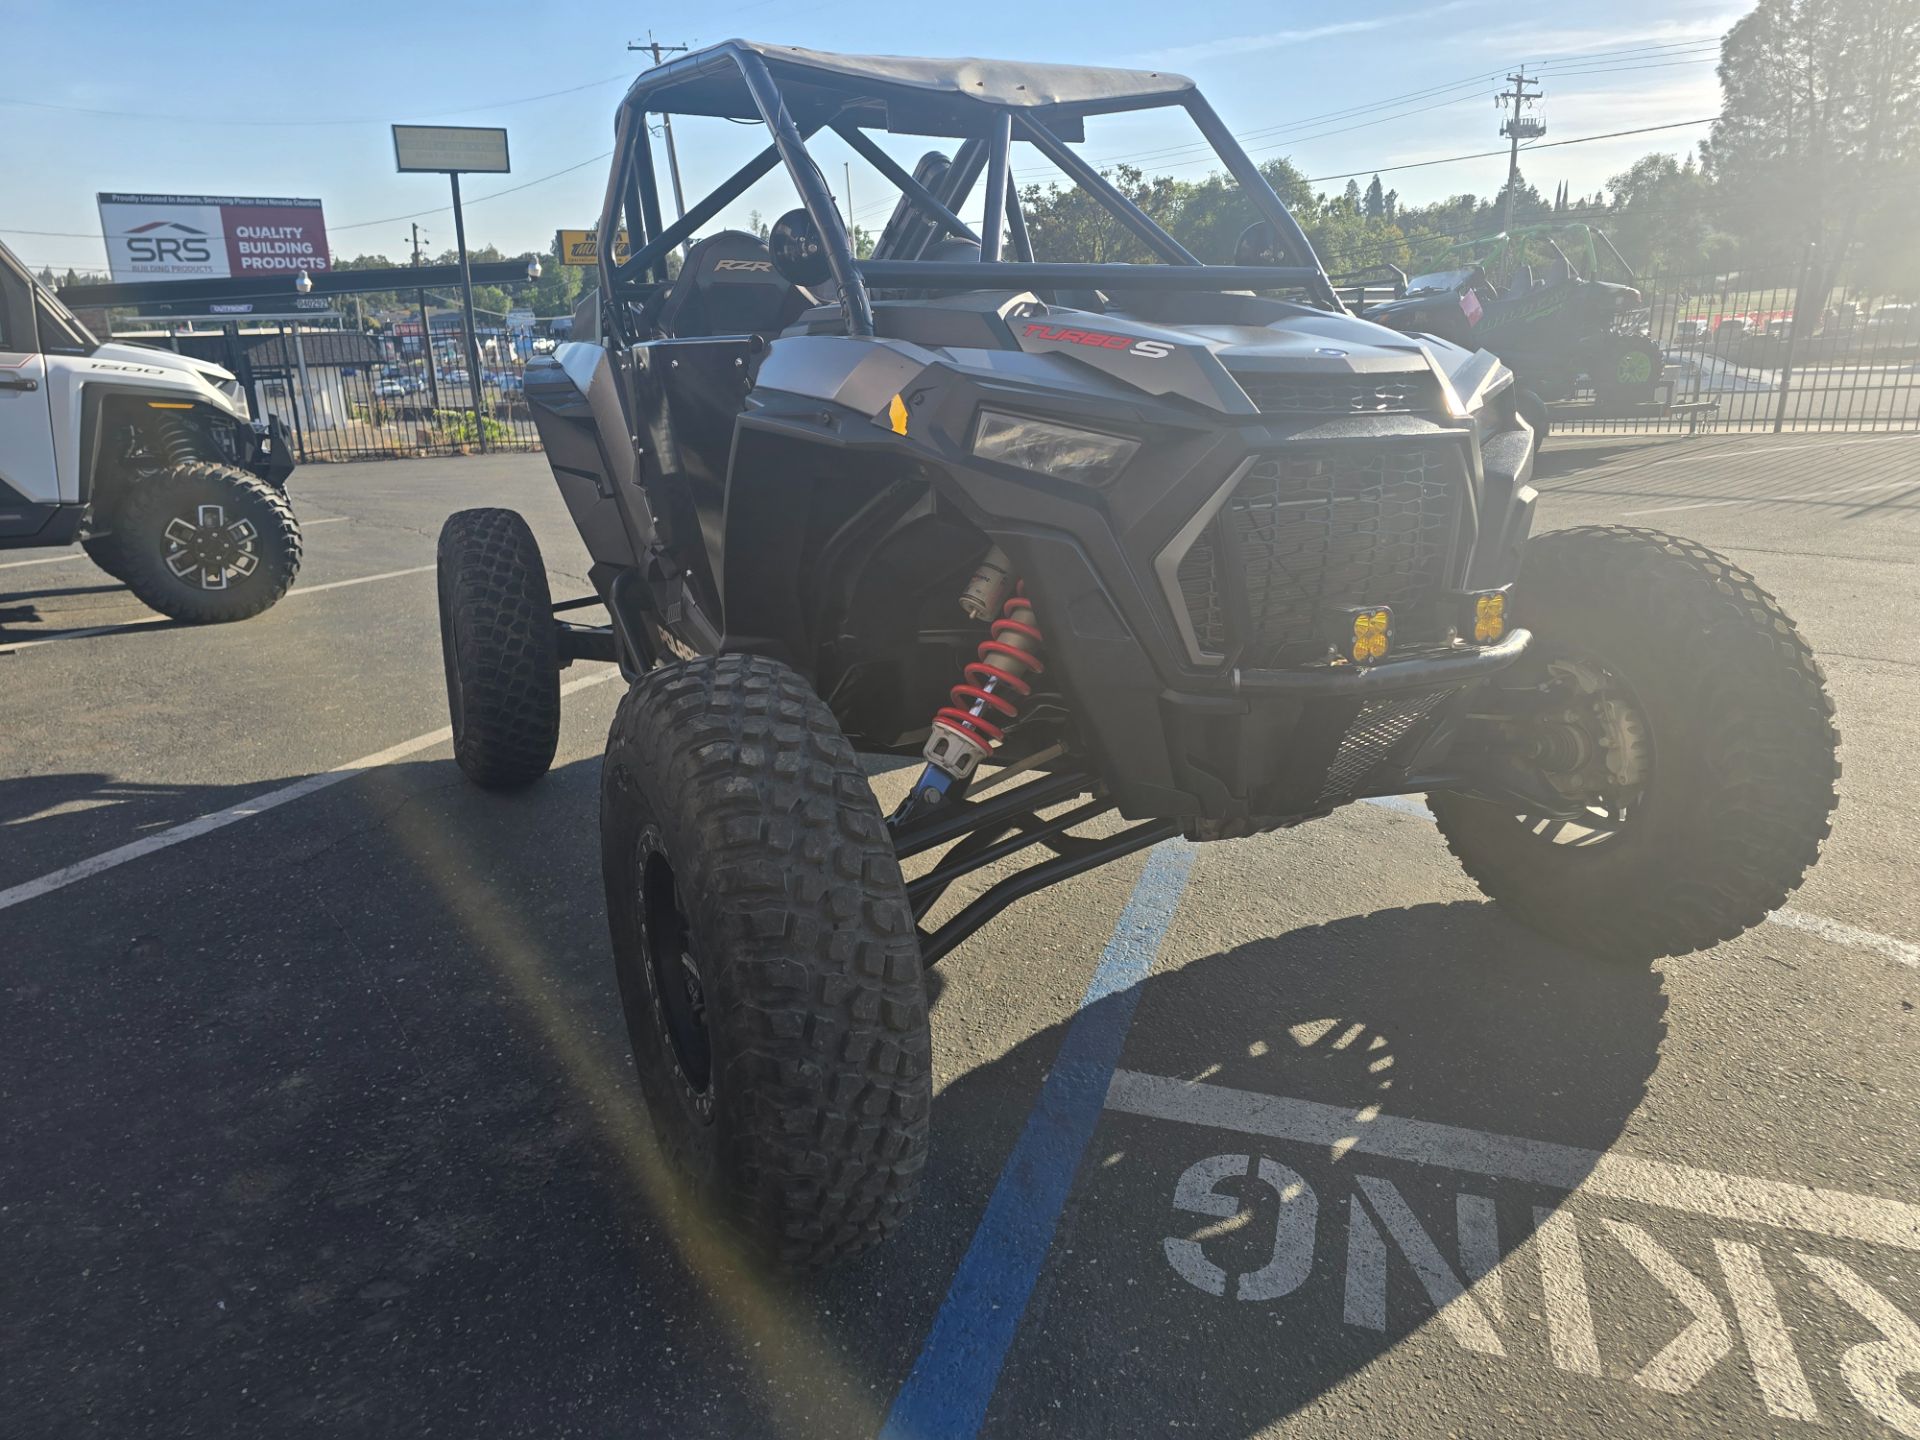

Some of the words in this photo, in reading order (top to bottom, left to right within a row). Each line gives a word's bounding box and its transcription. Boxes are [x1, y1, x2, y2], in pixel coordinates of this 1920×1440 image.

[112, 194, 139, 203] Proudly
[141, 195, 167, 203] Located
[236, 226, 303, 239] QUALITY
[126, 237, 211, 263] SRS
[239, 241, 313, 254] BUILDING
[131, 264, 171, 273] BUILDING
[171, 265, 213, 273] PRODUCTS
[241, 256, 326, 270] PRODUCTS
[713, 259, 773, 272] RZR
[1022, 324, 1135, 350] TURBO
[1129, 340, 1175, 359] S
[91, 363, 164, 374] 1500
